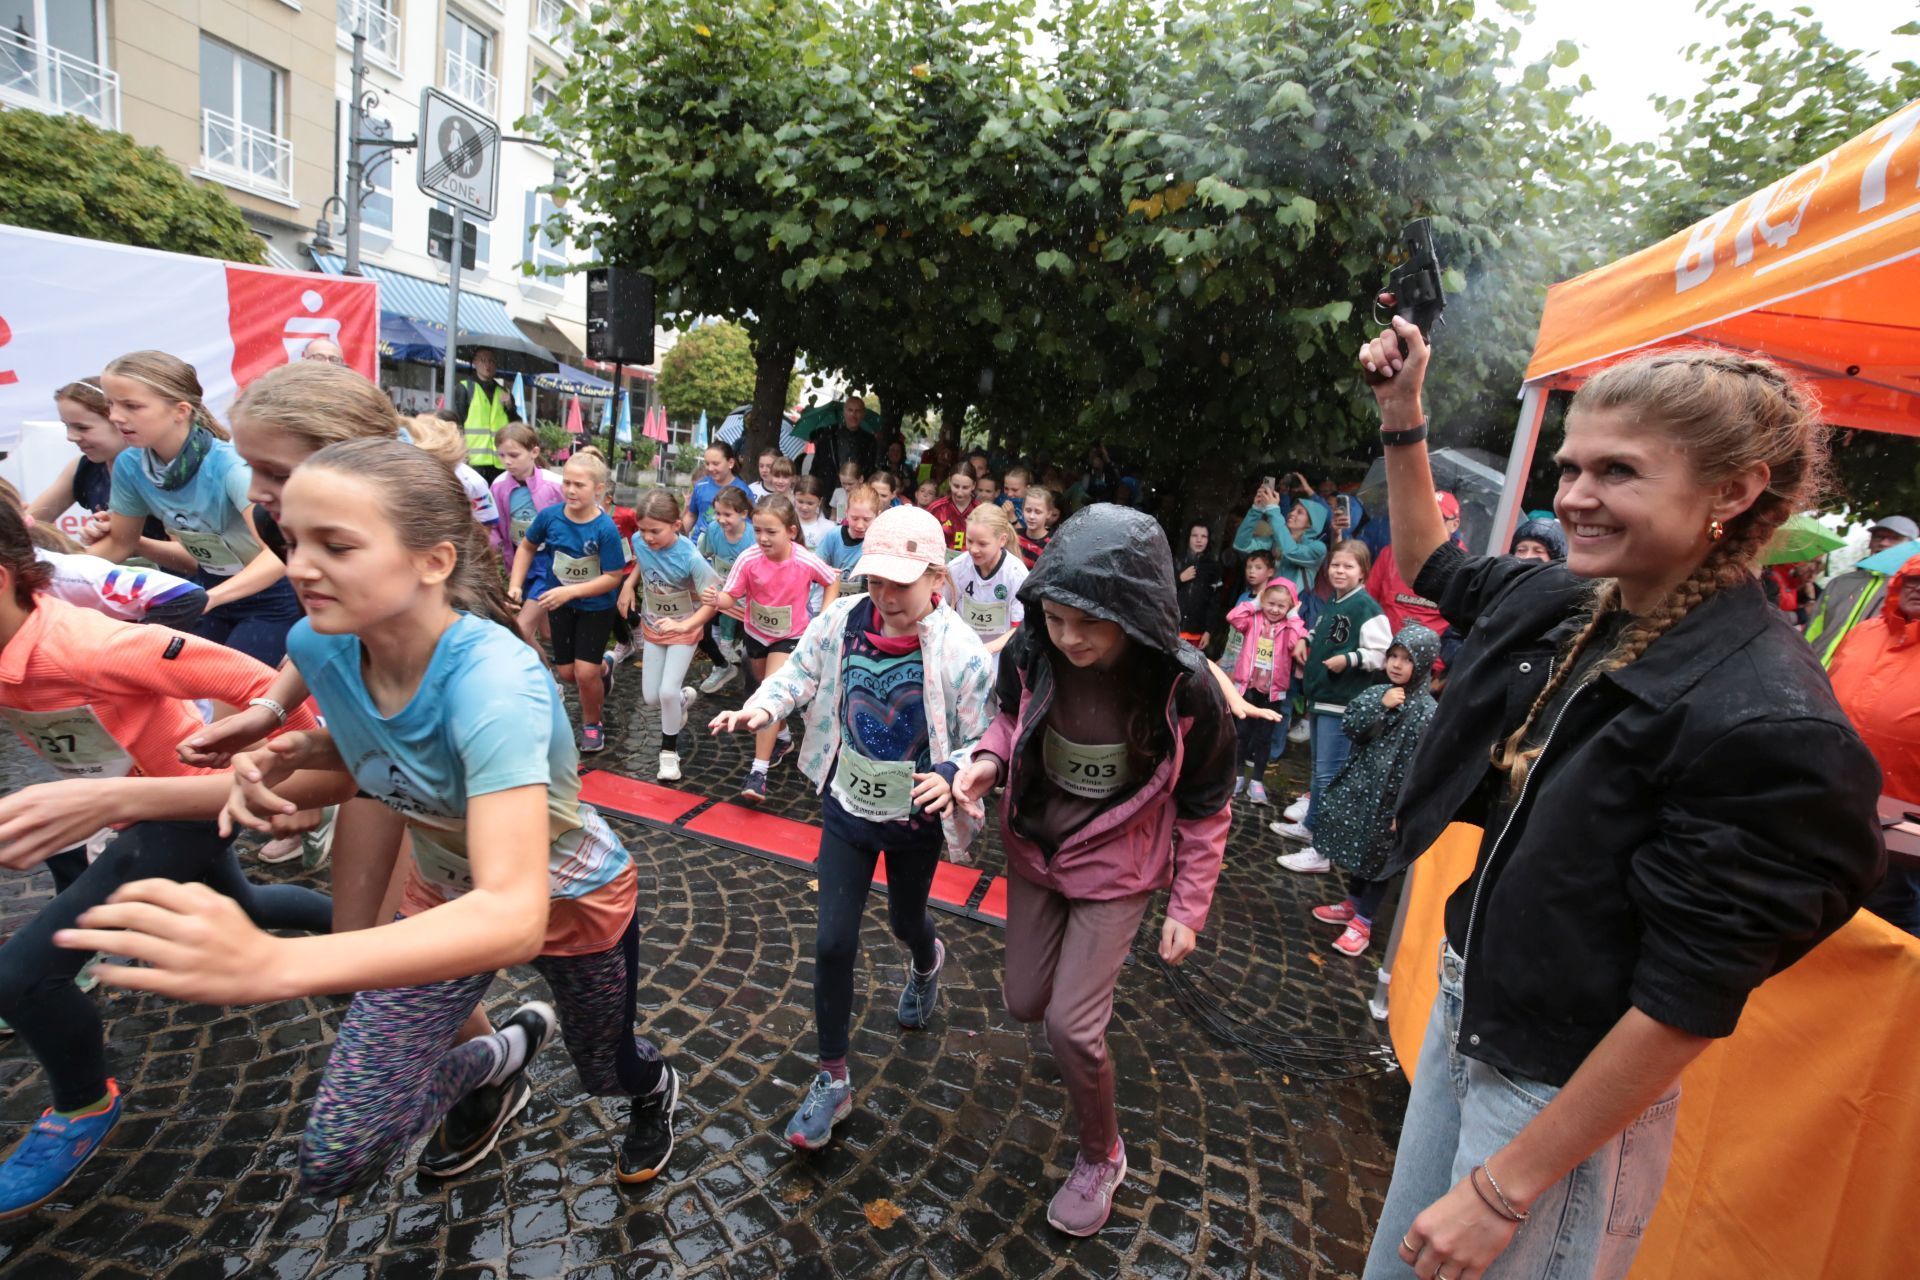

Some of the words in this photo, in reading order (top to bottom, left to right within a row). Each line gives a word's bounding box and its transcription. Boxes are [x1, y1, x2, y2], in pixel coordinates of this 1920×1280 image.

[1858, 104, 1920, 214] T
[441, 176, 476, 202] ZONE
[61, 515, 95, 535] er
[953, 531, 965, 550] 9
[565, 567, 589, 577] 708
[965, 581, 974, 597] 4
[655, 603, 679, 612] 701
[757, 612, 779, 625] 790
[971, 611, 992, 623] 743
[1068, 760, 1117, 778] 703
[849, 772, 887, 798] 735
